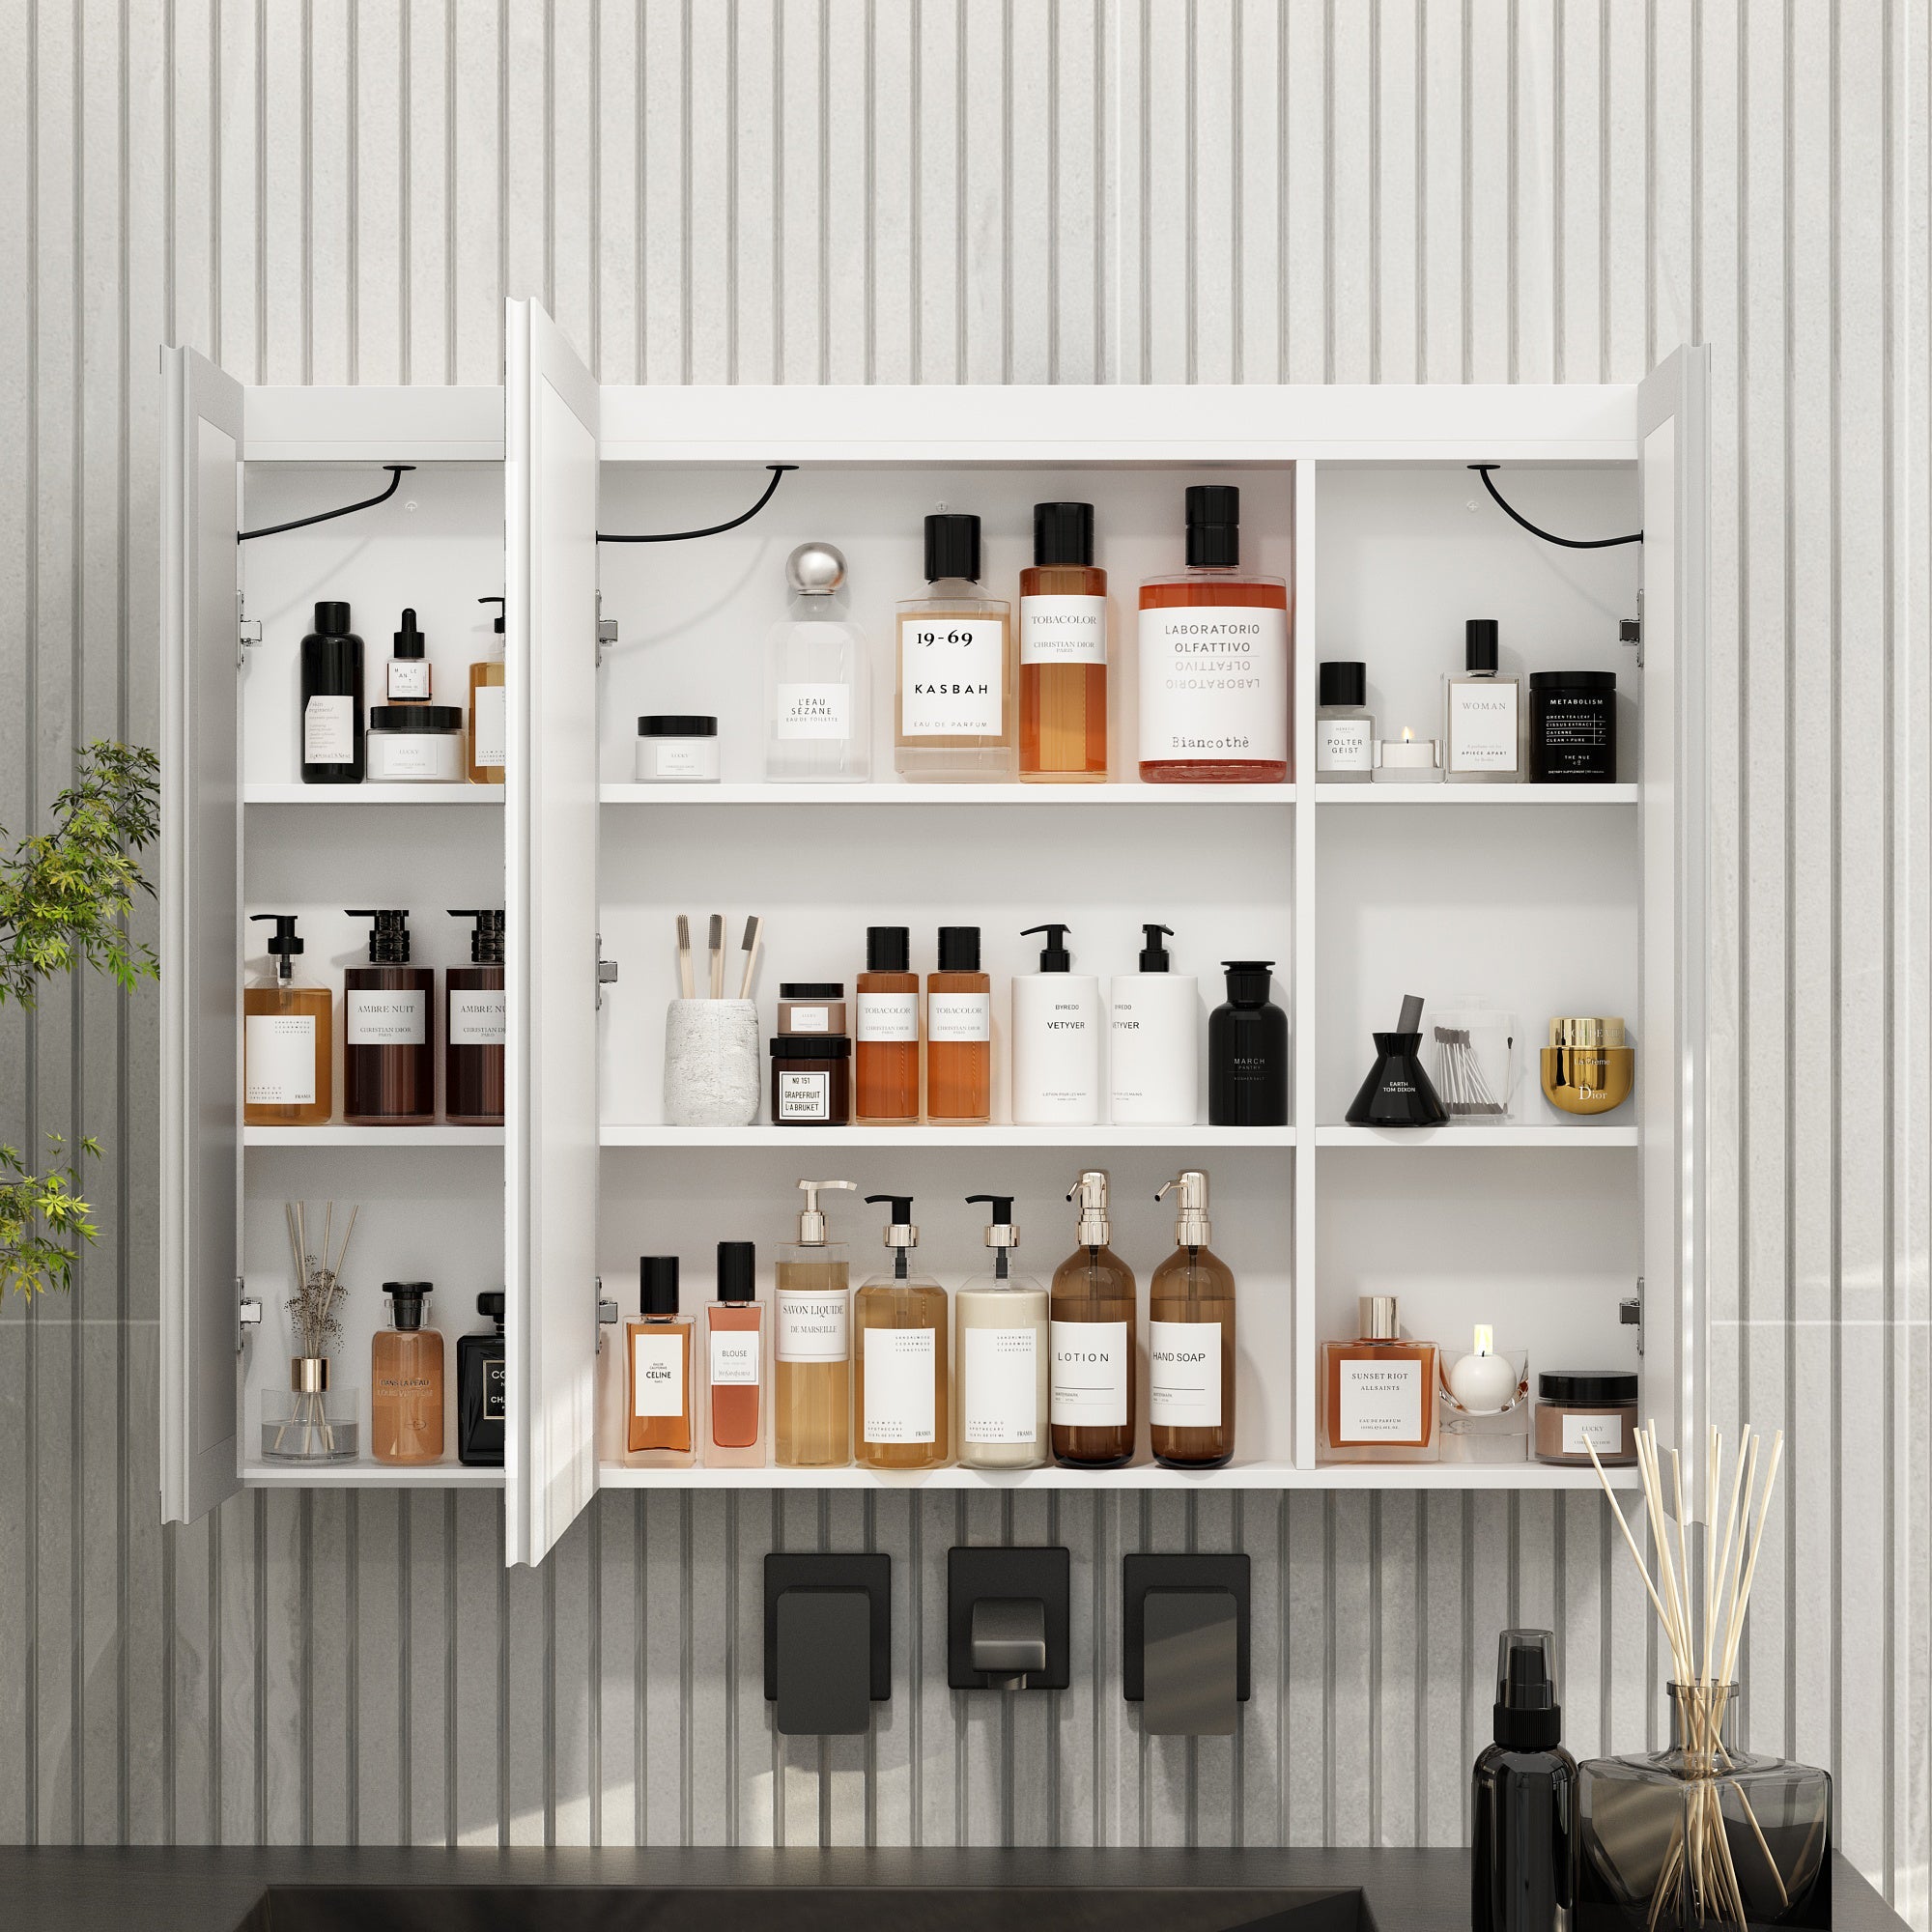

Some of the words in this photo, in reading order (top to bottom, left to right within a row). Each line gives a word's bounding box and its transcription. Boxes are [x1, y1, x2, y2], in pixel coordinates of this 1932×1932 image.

[1031, 615, 1096, 625] TOBACOLOR
[1165, 624, 1260, 635] LABORATORIO
[917, 629, 973, 647] 19-69
[1175, 642, 1250, 652] OLFATTIVO
[915, 684, 988, 695] KASBAH
[791, 706, 832, 715] SÉZANE
[1172, 736, 1249, 749] Biancothè
[357, 1005, 389, 1013] AMBRE
[392, 1005, 415, 1013] NUIT
[460, 1005, 493, 1013] AMBRE
[1046, 1021, 1086, 1030] VETYVER
[784, 1091, 821, 1099] GRAPEFRUIT
[1577, 1085, 1608, 1100] Dior
[794, 1103, 819, 1112] BRUKET
[783, 1305, 809, 1315] SAVON
[810, 1305, 843, 1318] LIQUIDE
[1058, 1351, 1110, 1362] LOTION
[1152, 1351, 1175, 1361] HAND
[1176, 1352, 1207, 1362] SOAP
